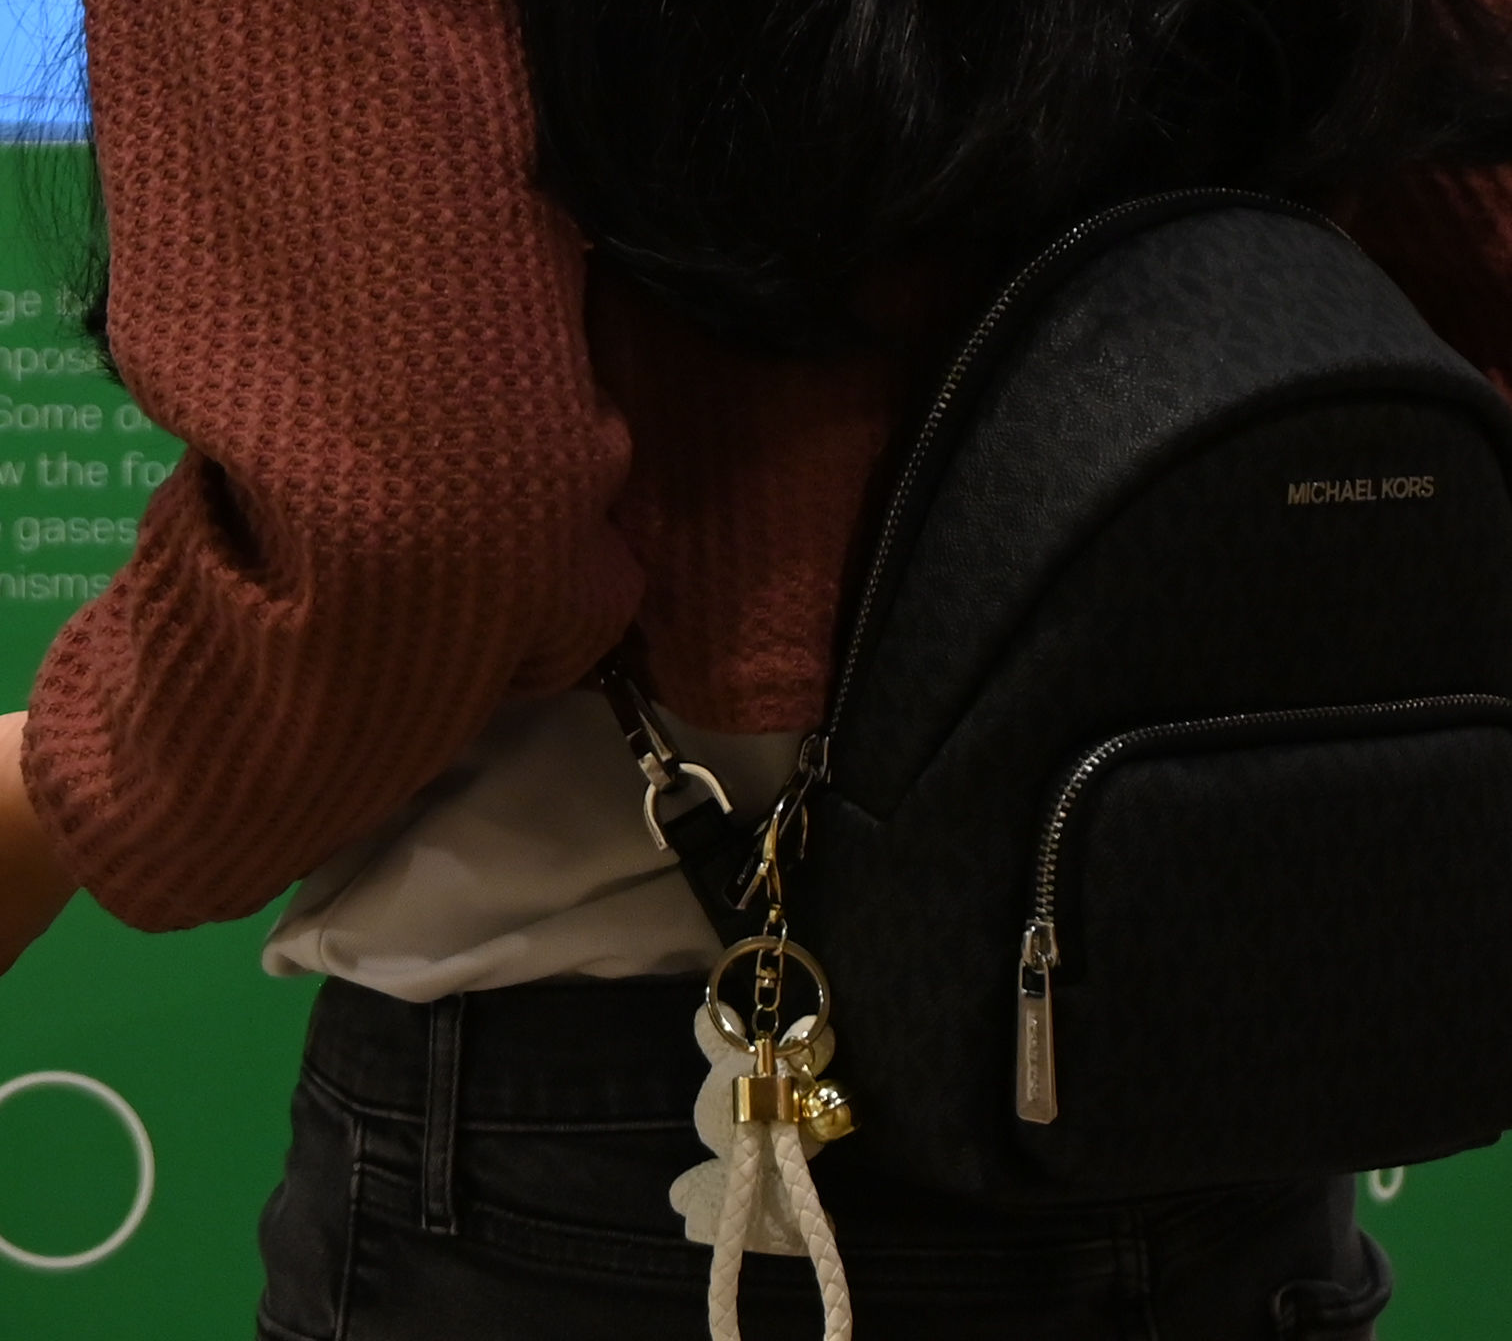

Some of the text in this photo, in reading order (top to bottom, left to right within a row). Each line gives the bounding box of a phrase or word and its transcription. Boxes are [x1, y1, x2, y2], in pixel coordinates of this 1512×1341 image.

[37, 450, 110, 488] the
[1287, 475, 1435, 506] MICHAEL KORS
[12, 513, 139, 552] gases
